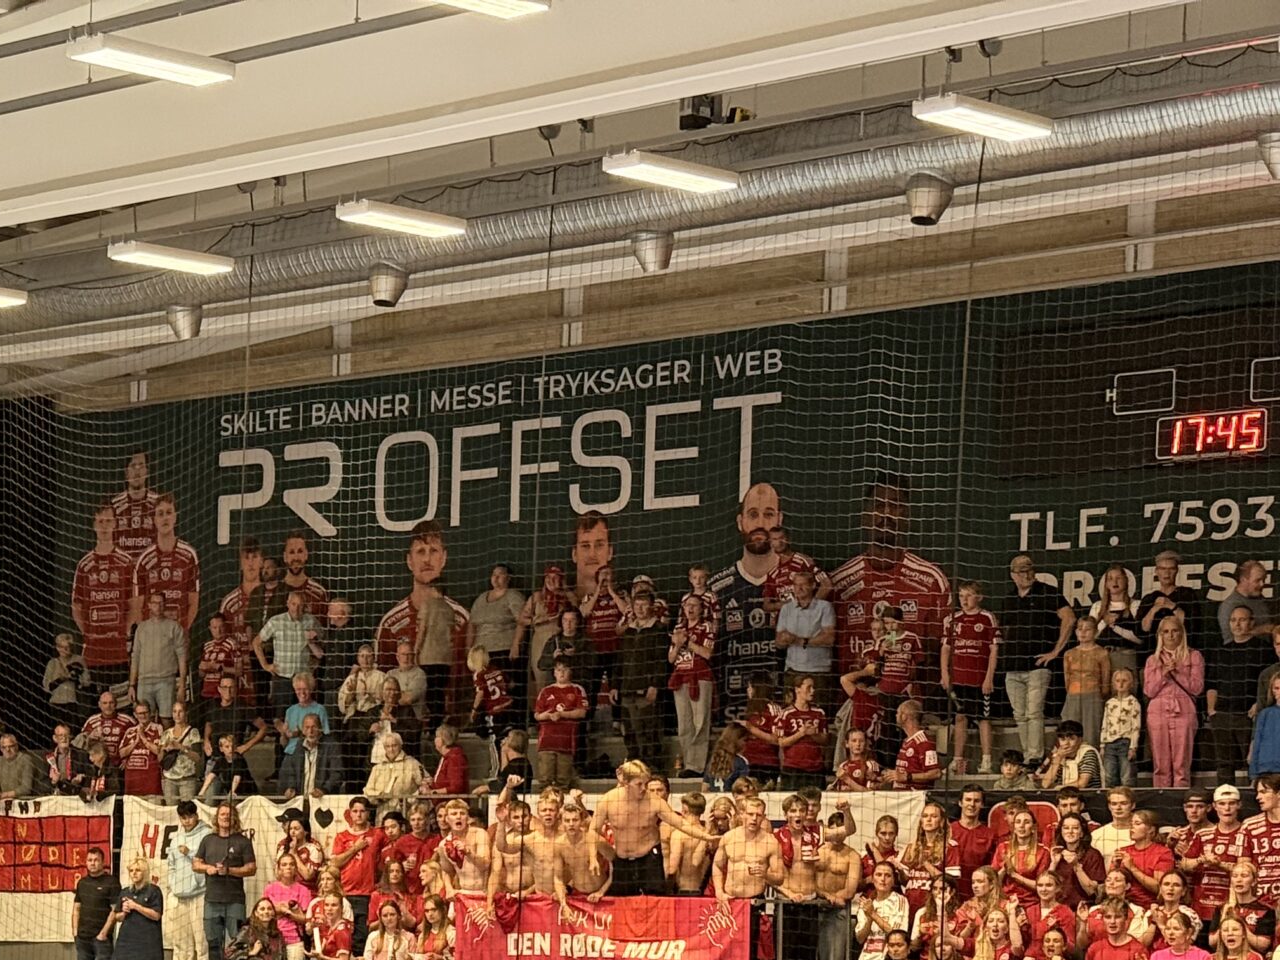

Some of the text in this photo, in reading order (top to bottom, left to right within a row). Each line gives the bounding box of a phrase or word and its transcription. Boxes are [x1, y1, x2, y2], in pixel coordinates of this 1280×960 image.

[219, 348, 783, 437] SKILTE BANNER MESSE TRYKSAGER WEB
[1171, 412, 1262, 454] 17:45
[217, 390, 783, 545] PR OFFSET
[1010, 496, 1275, 551] TLF. 7593
[1251, 838, 1269, 854] 13
[507, 932, 686, 960] DEN RØDE MUR
